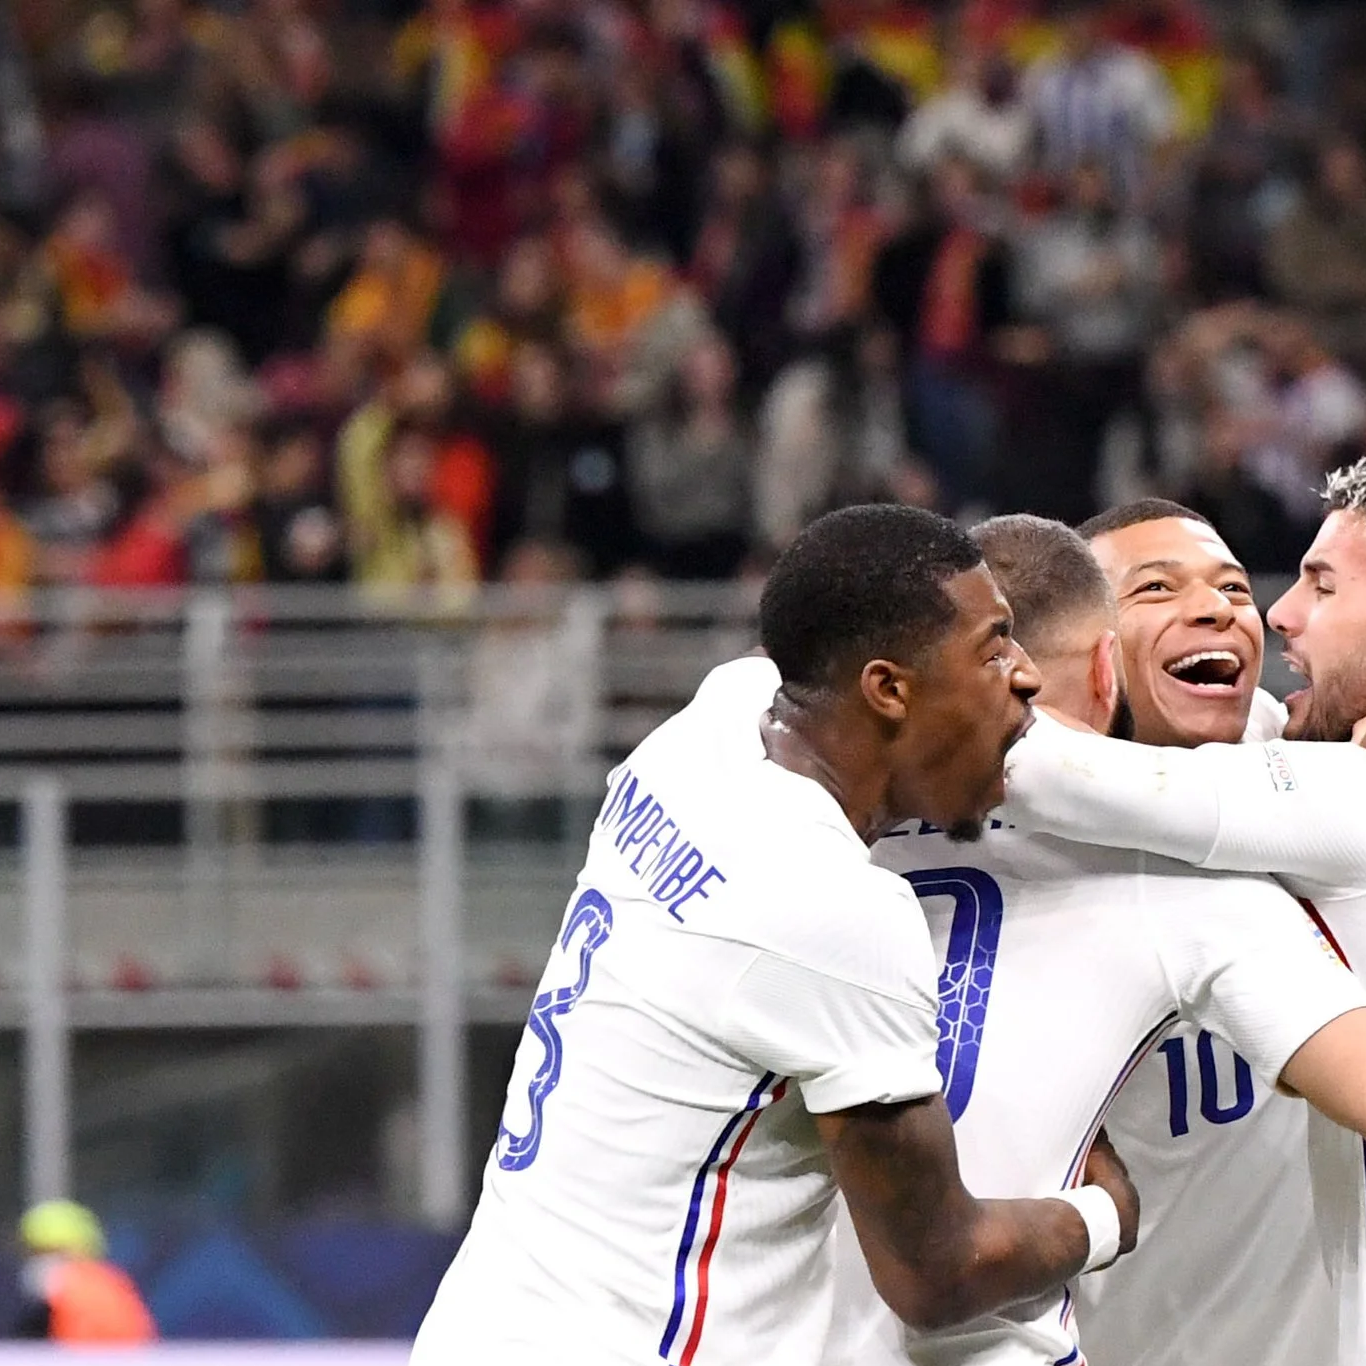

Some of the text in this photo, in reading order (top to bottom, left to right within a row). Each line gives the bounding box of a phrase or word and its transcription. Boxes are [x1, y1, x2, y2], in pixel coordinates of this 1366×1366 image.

[601, 764, 727, 924] IMPEMBE
[497, 888, 614, 1172] 3
[1157, 1028, 1254, 1138] 10
